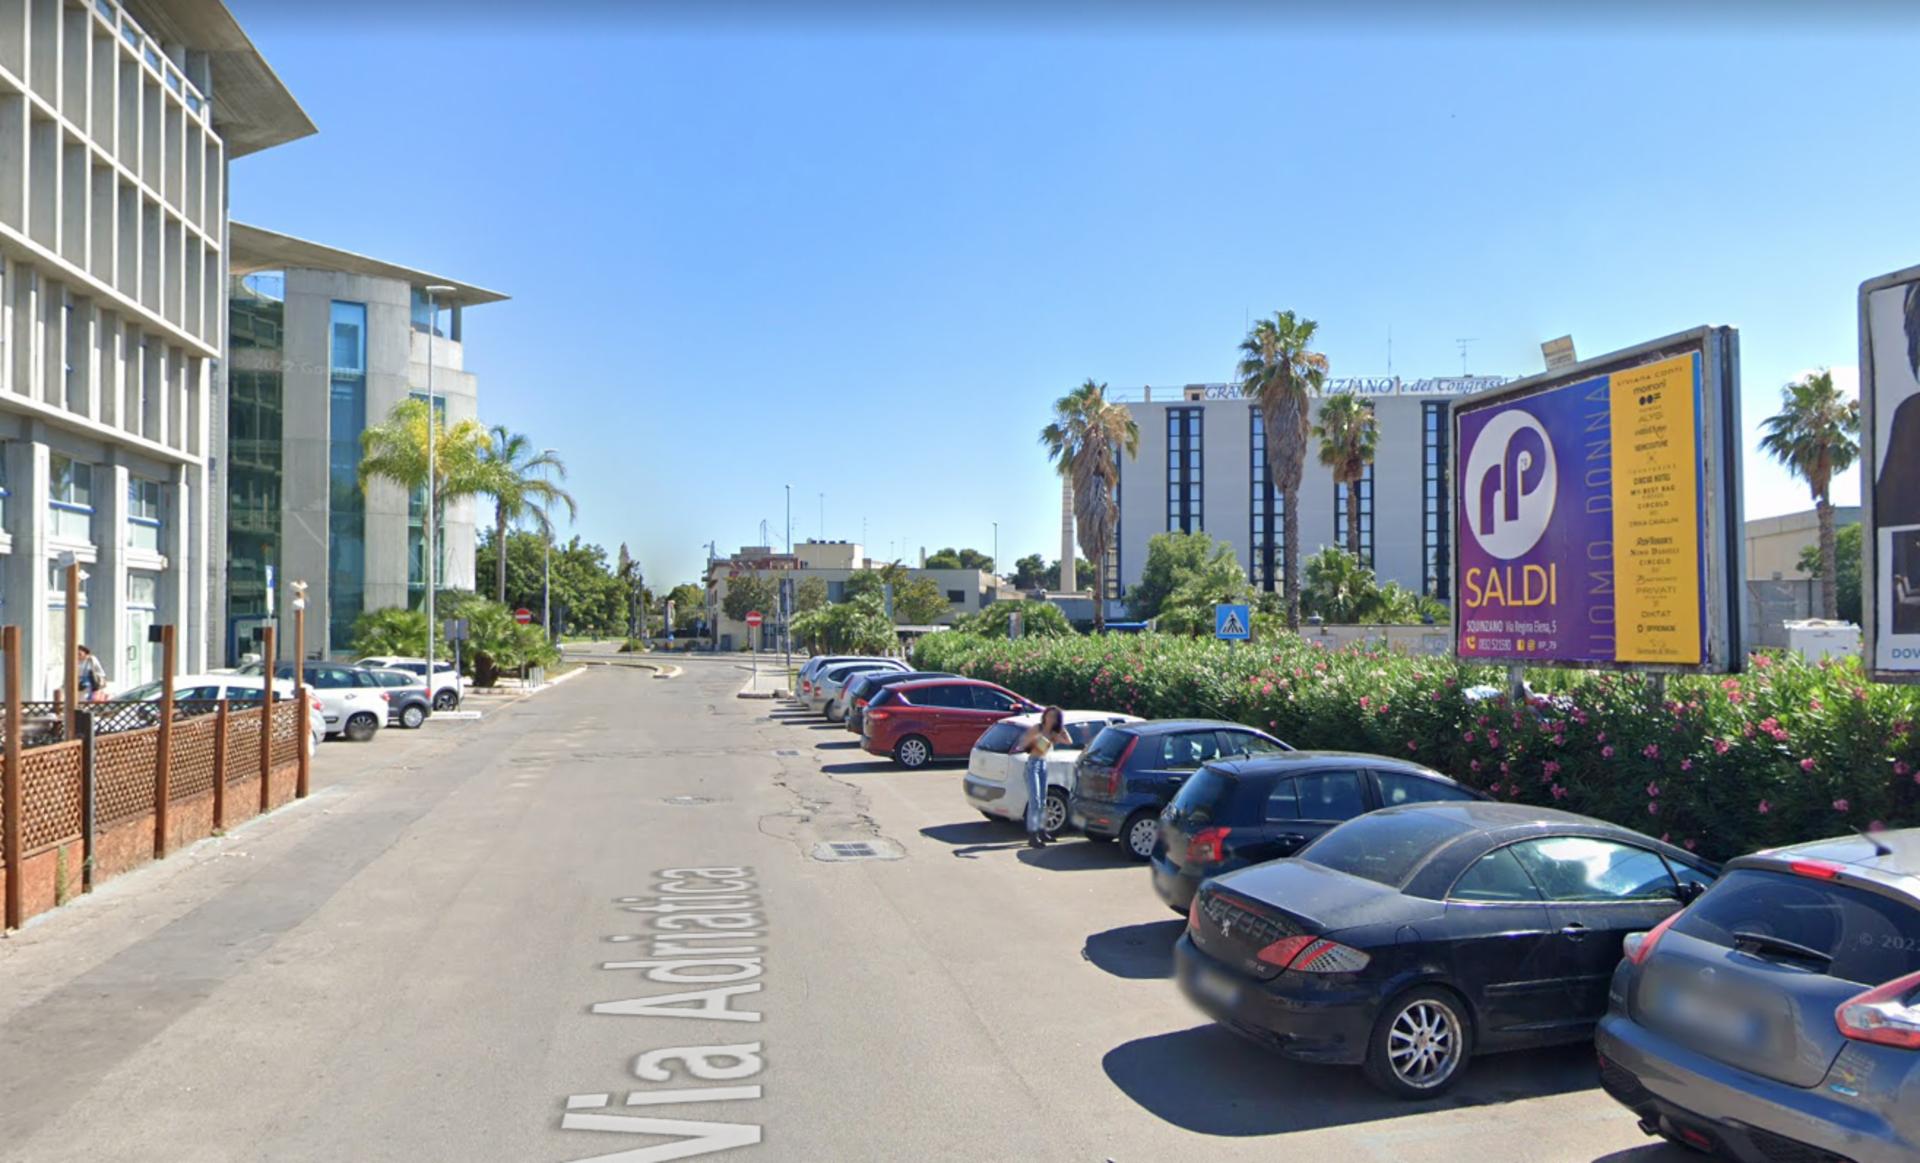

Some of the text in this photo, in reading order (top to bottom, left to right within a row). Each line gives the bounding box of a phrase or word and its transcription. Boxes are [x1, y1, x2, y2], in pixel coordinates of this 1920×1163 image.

[1326, 376, 1394, 395] IZIANO
[1584, 384, 1615, 656] UOMO DONNA
[1465, 562, 1557, 608] SALDI
